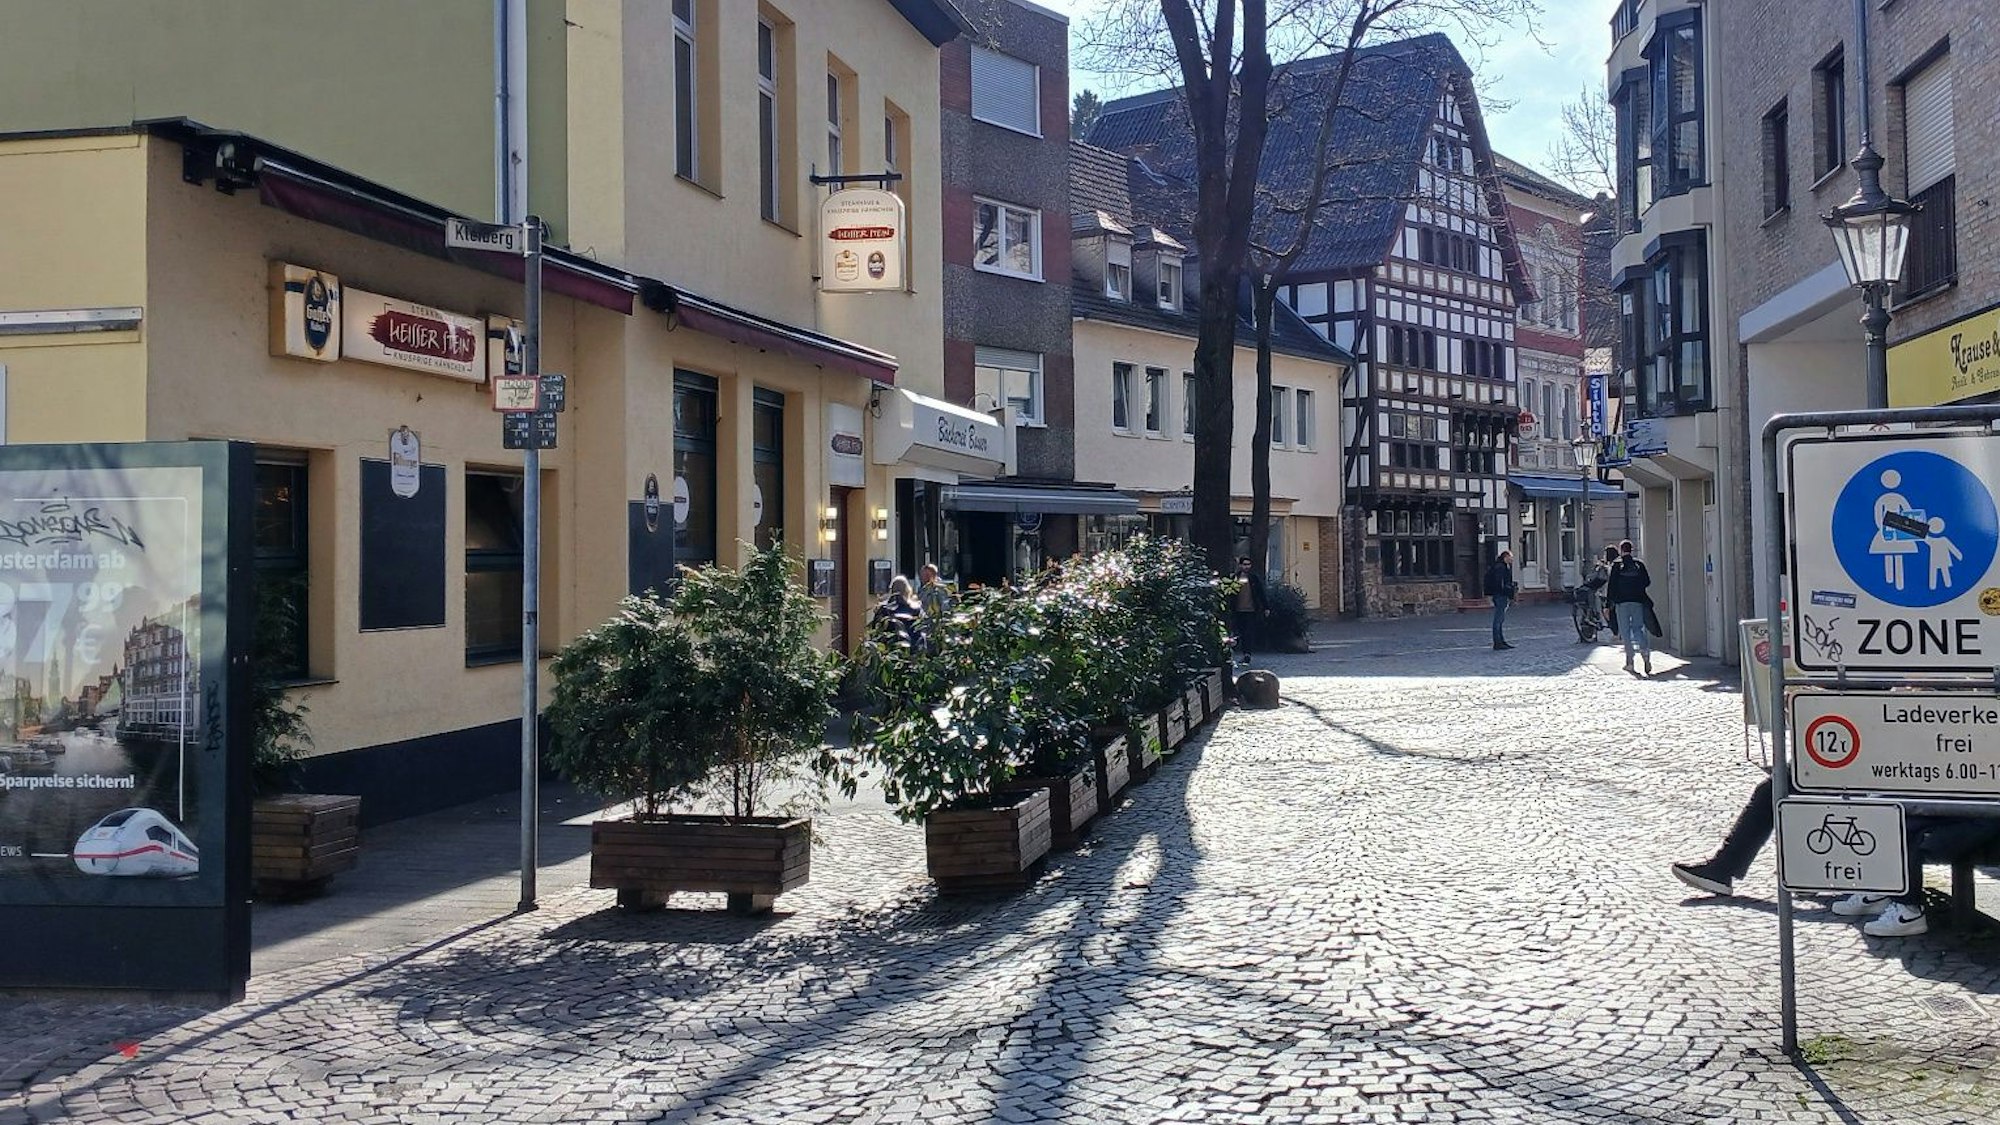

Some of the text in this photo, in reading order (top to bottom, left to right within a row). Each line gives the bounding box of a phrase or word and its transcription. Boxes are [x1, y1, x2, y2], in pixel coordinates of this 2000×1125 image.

[455, 222, 513, 249] Kleiberg
[389, 318, 470, 355] HEISSER STEIN
[1950, 332, 1991, 375] Krause
[0, 550, 125, 570] sterdam ab
[75, 623, 102, 664] €
[1857, 619, 1982, 655] ZONE
[1883, 704, 1998, 725] Ladeverke
[1936, 734, 1972, 753] frei
[76, 773, 135, 789] sichern!
[1872, 761, 2000, 782] werktags 6.00-1
[1825, 861, 1862, 880] frei
